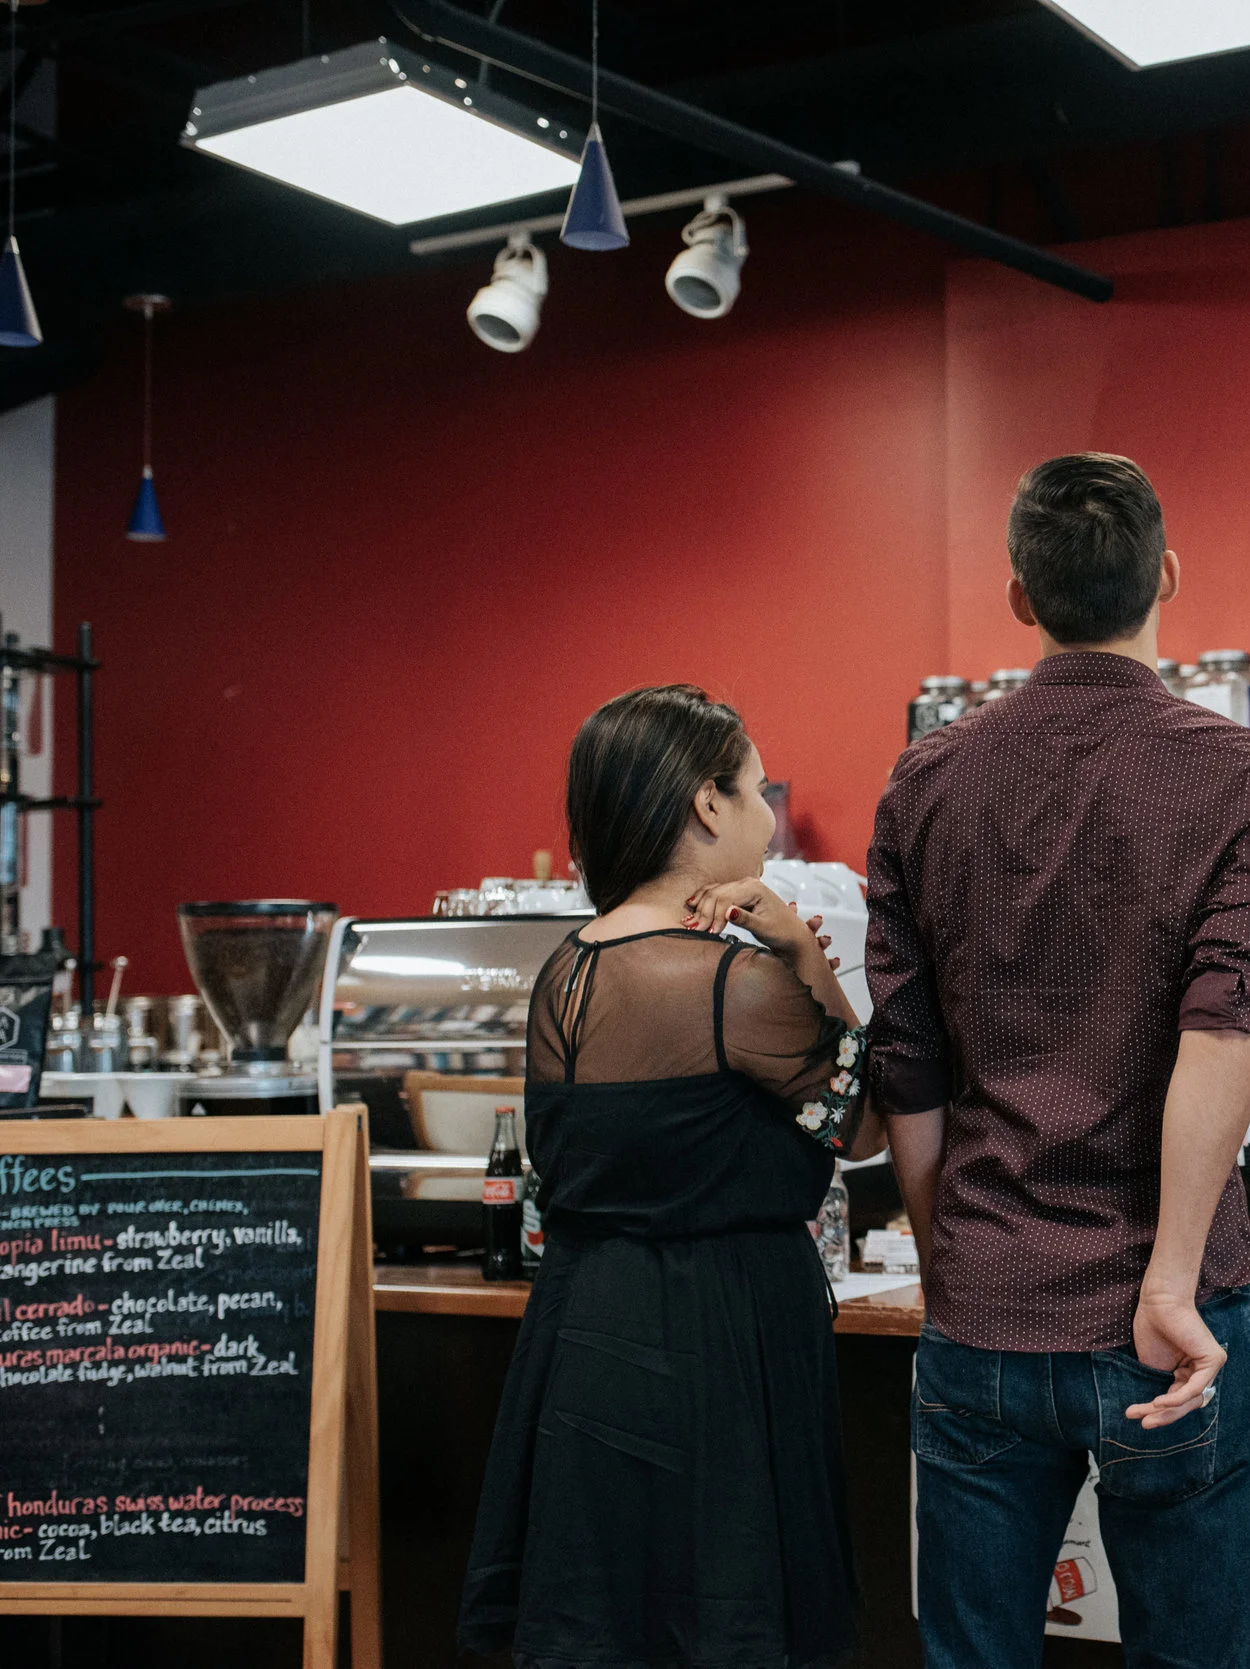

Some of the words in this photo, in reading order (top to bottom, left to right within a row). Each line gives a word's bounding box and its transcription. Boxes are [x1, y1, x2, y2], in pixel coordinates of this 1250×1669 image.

[10, 1205, 75, 1220] BREWED
[79, 1203, 100, 1216] BY
[107, 1200, 146, 1215] POUR
[34, 1215, 79, 1229] PRESS
[116, 1220, 231, 1255] strawberry,
[233, 1219, 303, 1246] vanilla,
[0, 1253, 98, 1287] angerine
[102, 1251, 153, 1273] from
[157, 1246, 205, 1270] Zeal
[111, 1288, 215, 1317] chocolate,
[218, 1291, 283, 1320] pecan,
[0, 1320, 53, 1342] offee
[56, 1317, 102, 1337] from
[108, 1313, 154, 1335] Zeal
[46, 1336, 125, 1367] marcala
[214, 1333, 259, 1358] dark
[78, 1360, 134, 1387] fudge,
[202, 1353, 248, 1377] from
[250, 1351, 299, 1377] Zeal
[7, 1489, 109, 1518] honduras
[115, 1493, 166, 1513] swiss
[169, 1485, 226, 1512] water
[230, 1496, 304, 1523] process
[38, 1523, 98, 1541] cocoa,
[100, 1513, 156, 1537] black
[158, 1512, 201, 1536] tea,
[203, 1510, 268, 1536] citrus
[38, 1538, 92, 1562] Zeal
